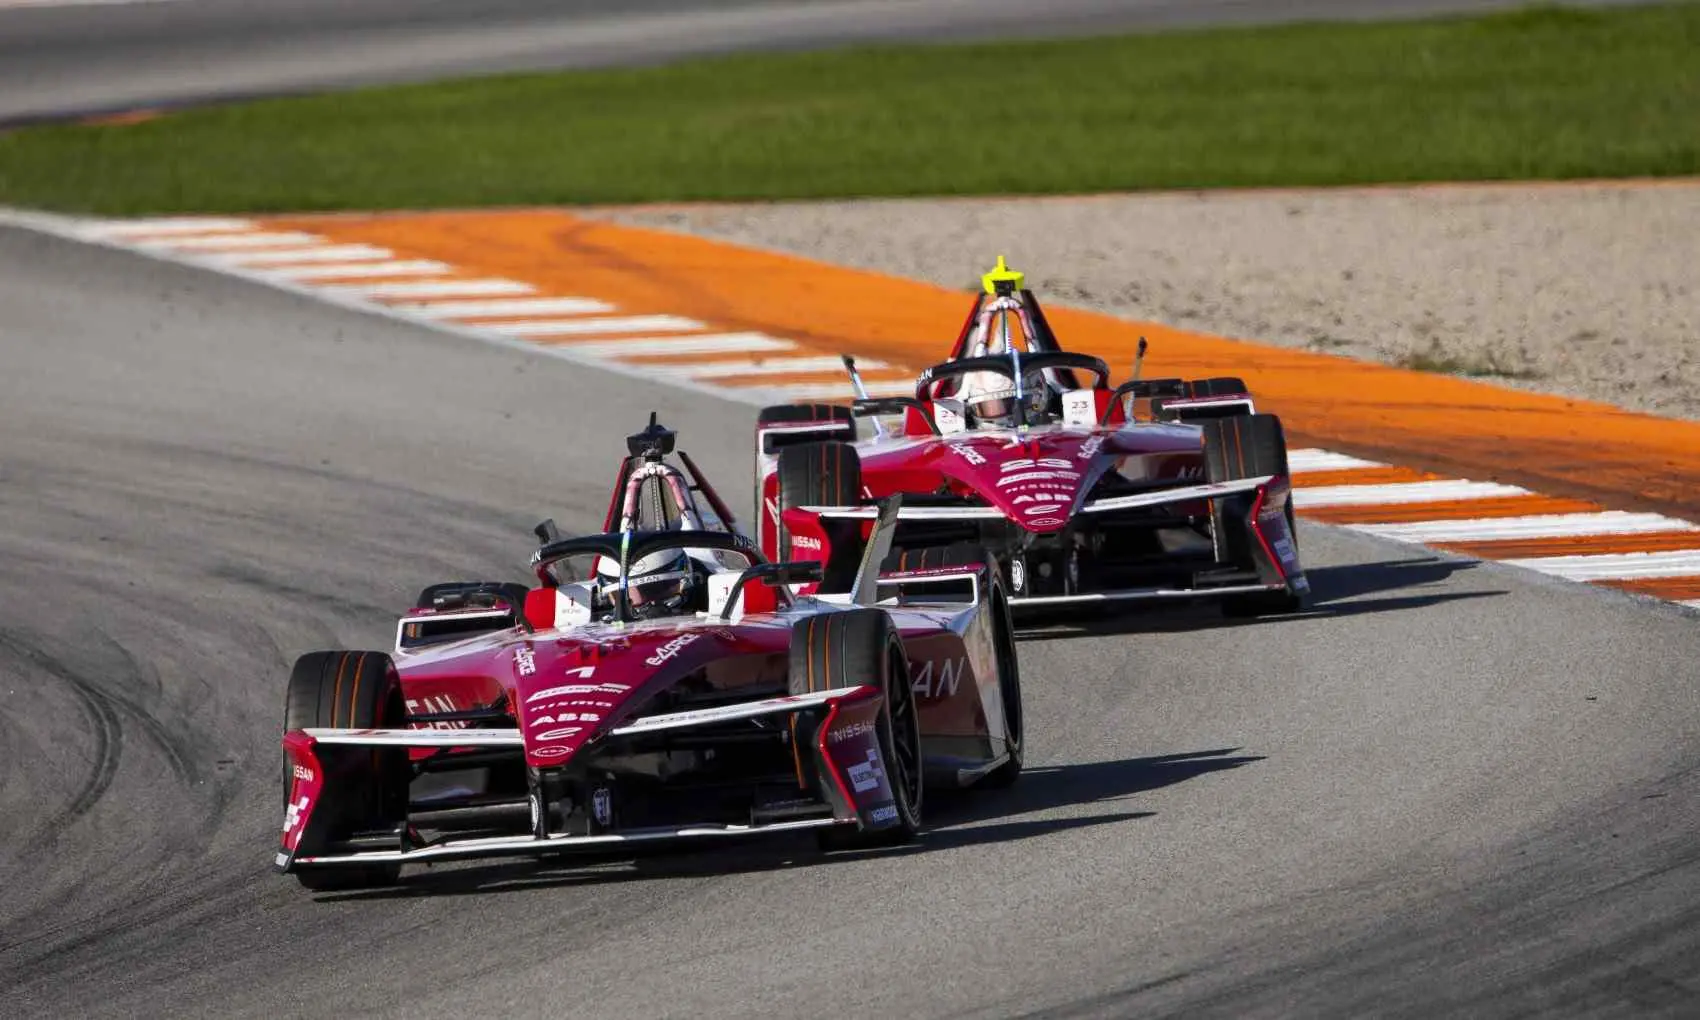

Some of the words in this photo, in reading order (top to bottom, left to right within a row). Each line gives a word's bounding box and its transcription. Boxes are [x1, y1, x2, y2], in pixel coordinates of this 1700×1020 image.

[1000, 458, 1073, 473] 23
[791, 535, 821, 550] NISSAN
[565, 666, 596, 678] 1
[529, 713, 601, 728] ABB
[833, 719, 876, 743] NISSAN
